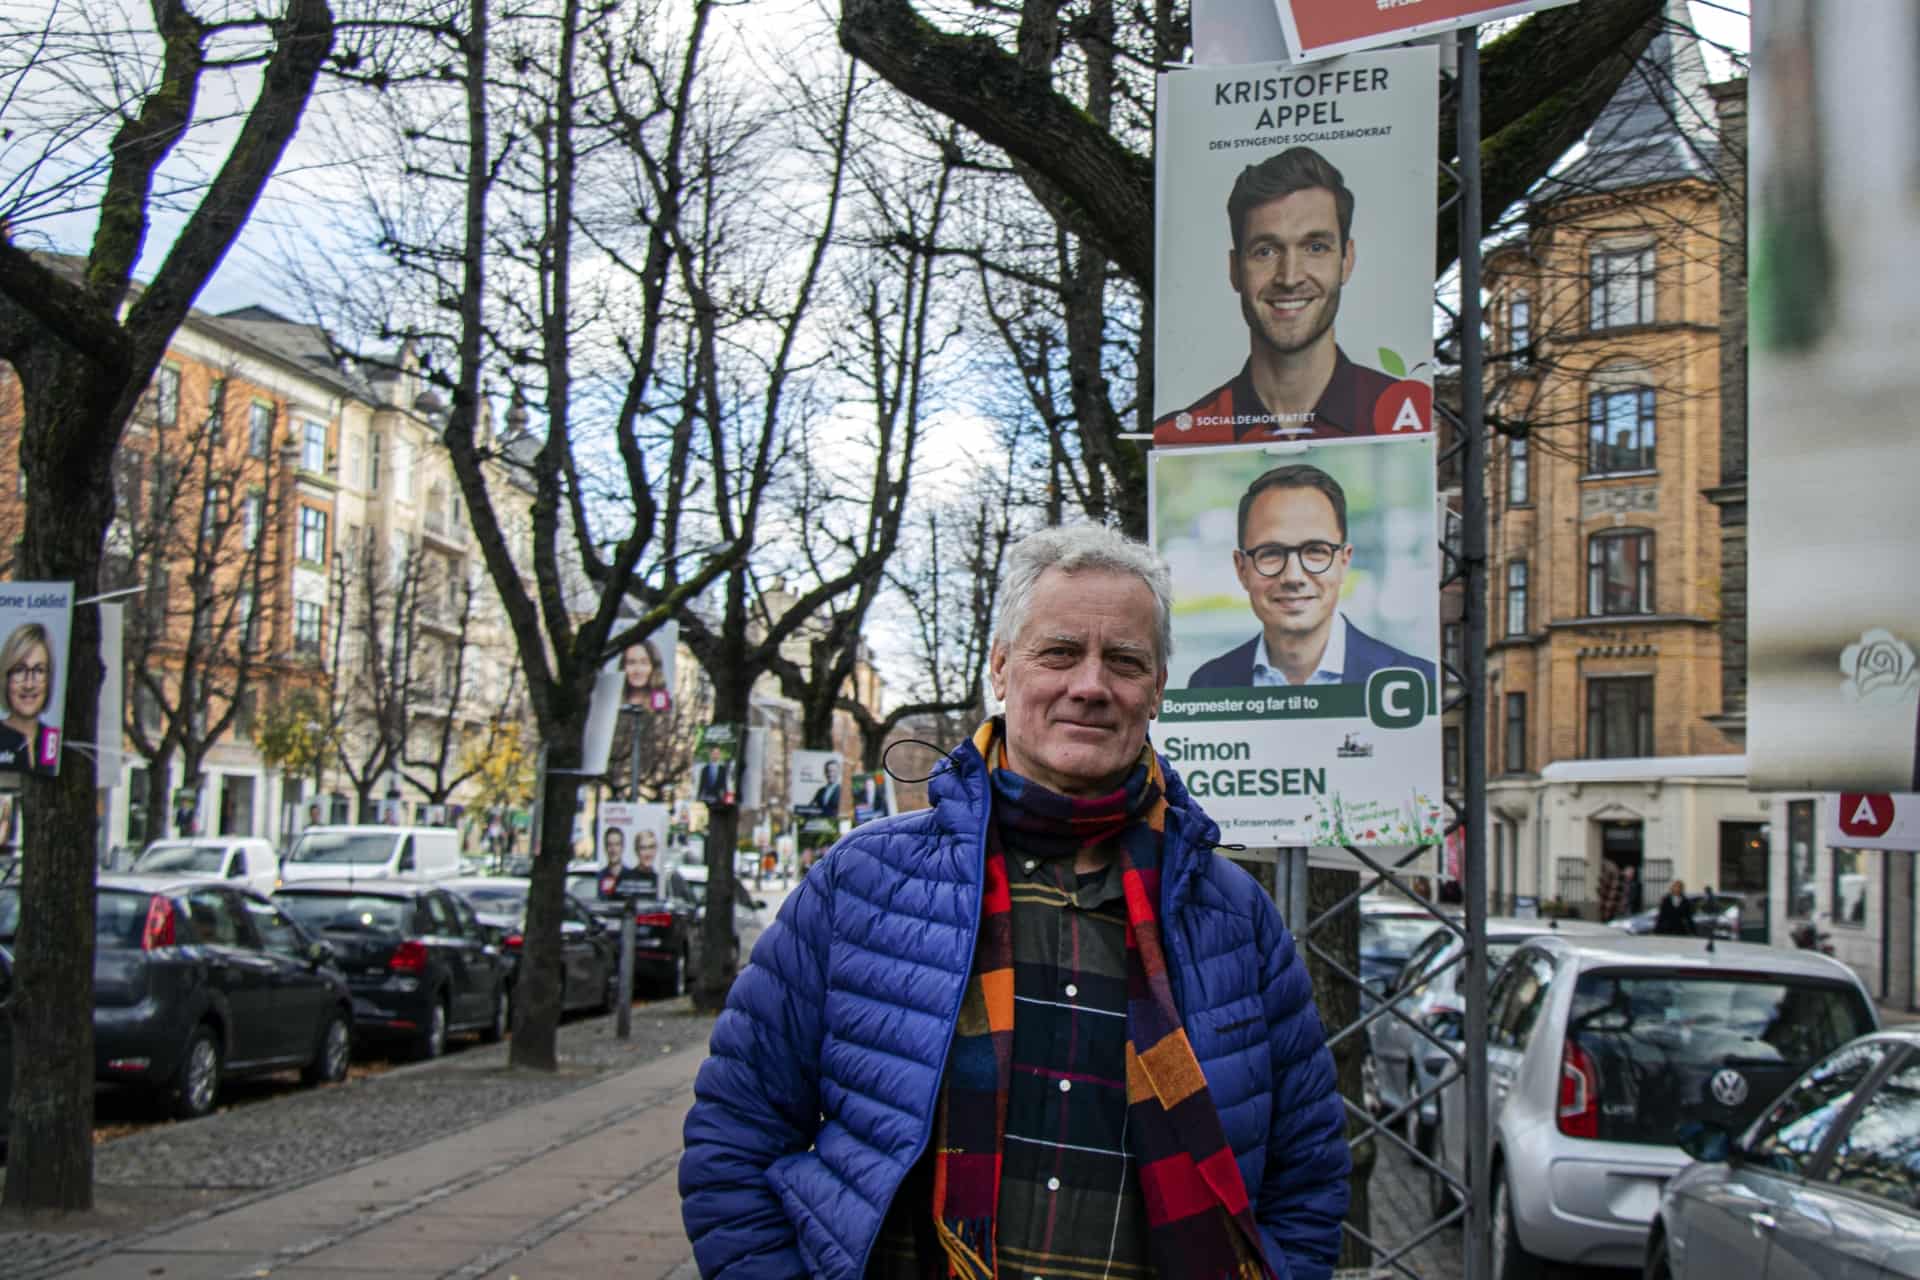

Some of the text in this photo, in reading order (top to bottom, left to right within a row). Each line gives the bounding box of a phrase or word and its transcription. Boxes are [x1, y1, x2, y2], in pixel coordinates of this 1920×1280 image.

[1215, 67, 1389, 105] KRISTOFFER
[1256, 101, 1344, 130] APPEL
[1209, 126, 1392, 150] DEN SYNGENDE SOCIALDEMOKRAT
[1196, 413, 1316, 426] SOCIALDEMOKRATIET
[1391, 397, 1423, 431] A
[0, 596, 24, 608] one
[1162, 696, 1319, 715] Borgmester og far til to
[1381, 681, 1411, 717] C
[1163, 737, 1250, 762] Simon
[1186, 767, 1326, 797] GGESEN
[1233, 817, 1295, 828] Konservative
[1850, 796, 1878, 825] A
